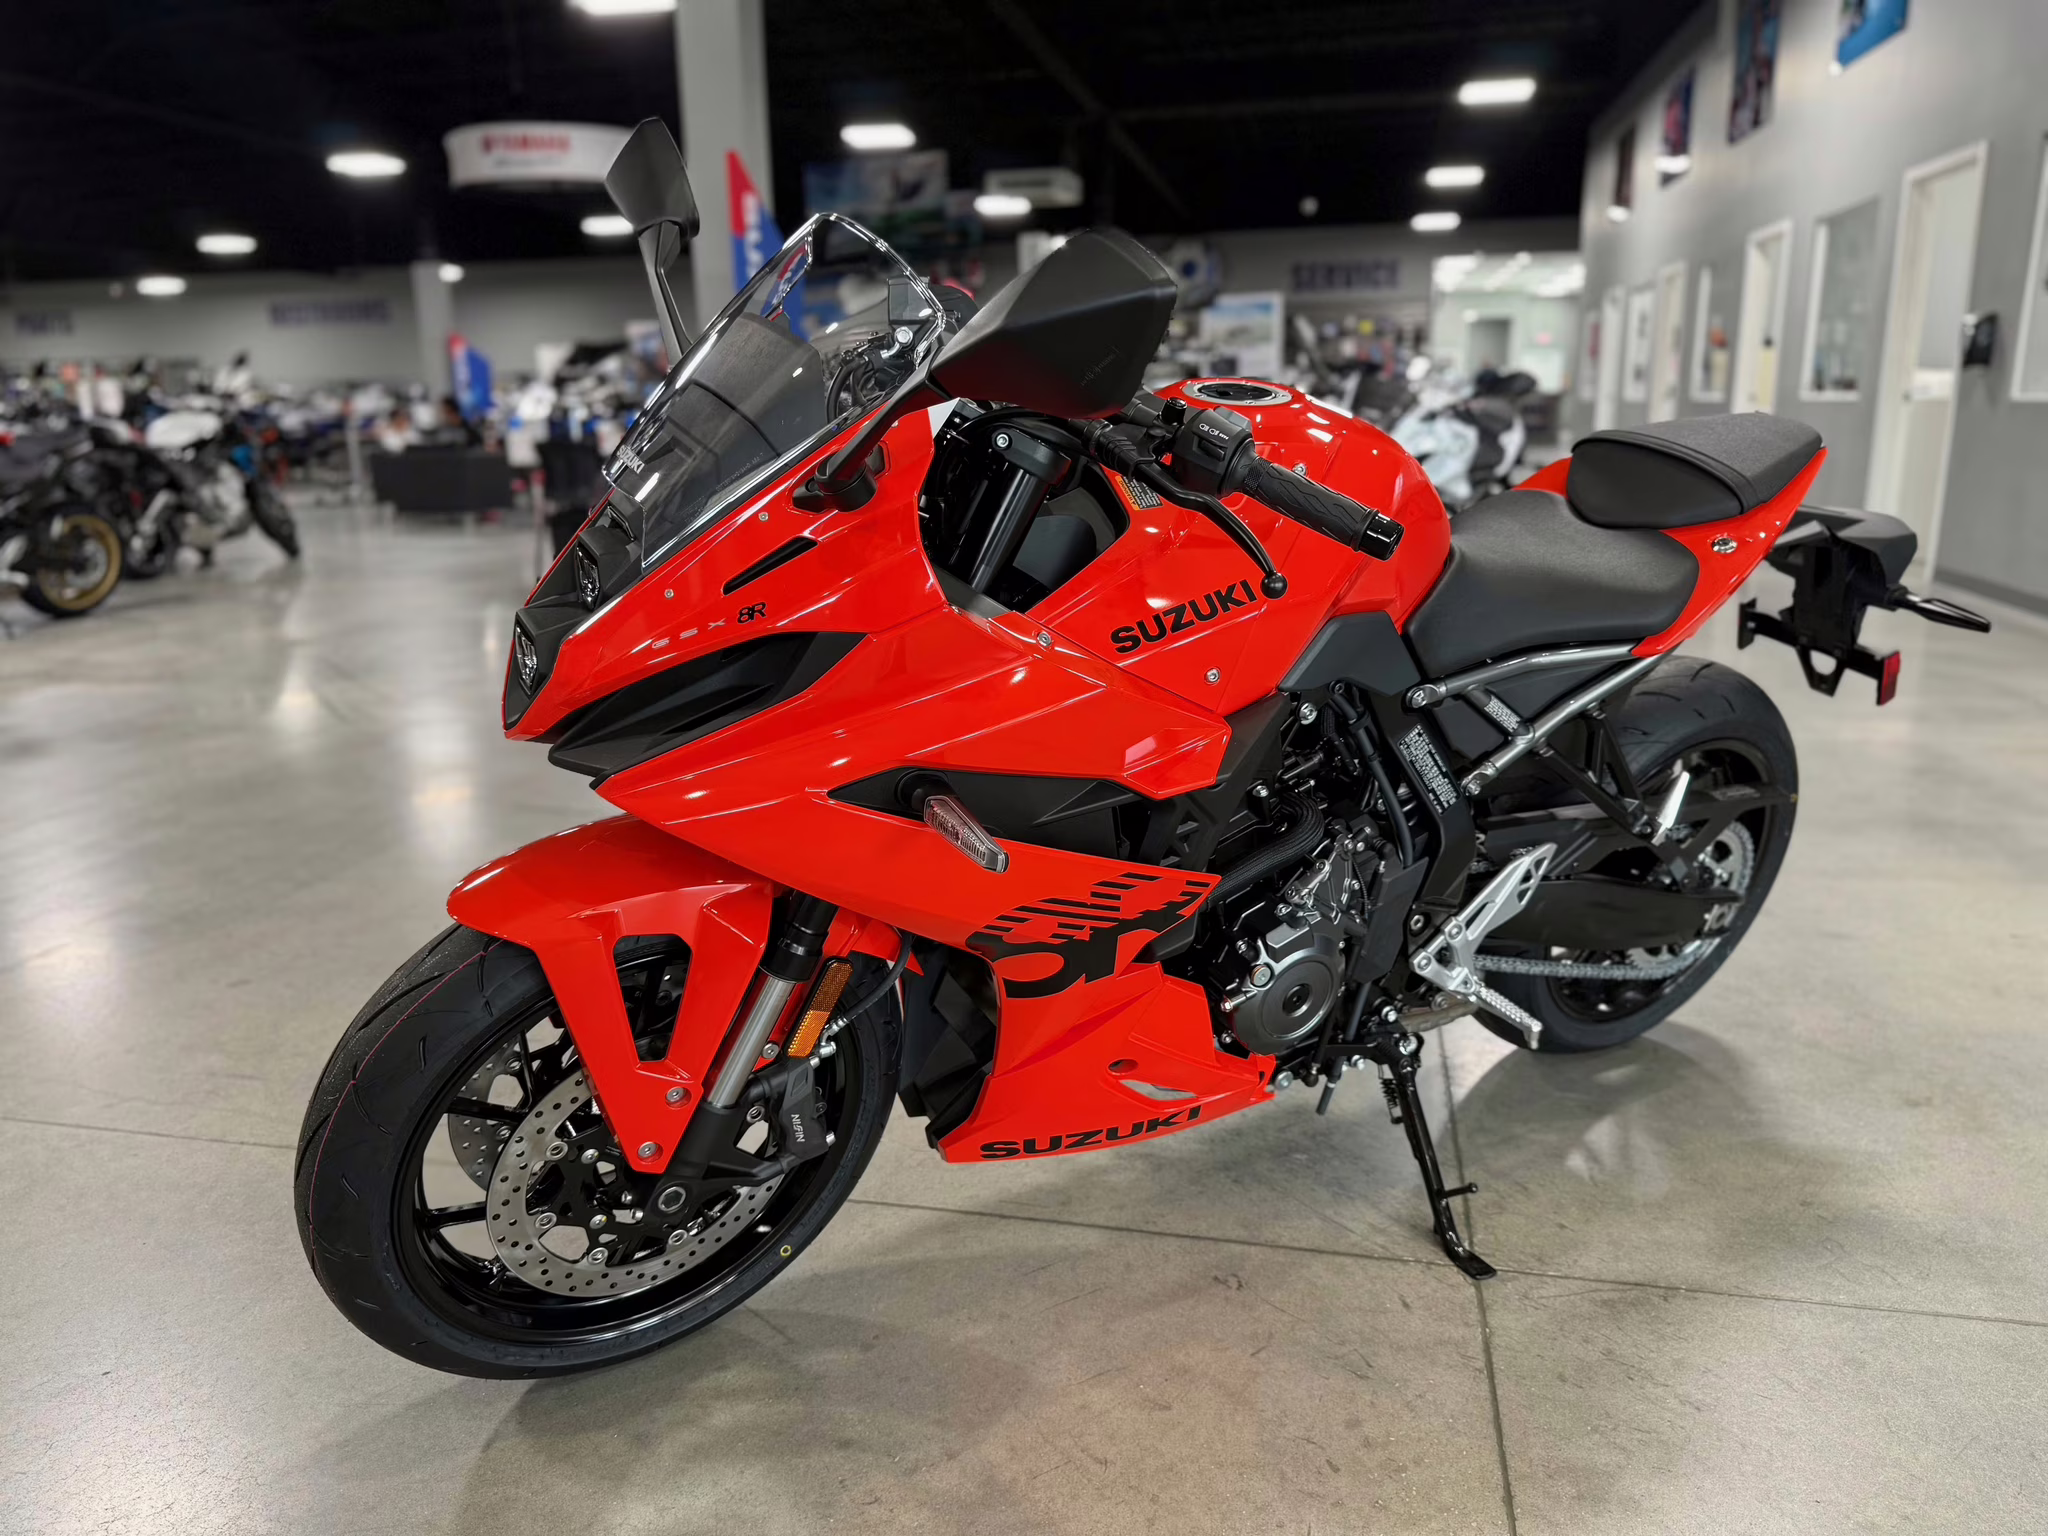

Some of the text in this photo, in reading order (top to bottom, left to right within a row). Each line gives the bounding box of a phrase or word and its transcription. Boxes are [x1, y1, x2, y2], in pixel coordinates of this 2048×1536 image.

[616, 445, 645, 474] SUZUKI
[652, 601, 767, 649] GSX 8R
[1110, 579, 1258, 654] SUZUKI
[791, 1114, 806, 1142] NISSIN
[979, 1105, 1202, 1159] SUZUKI
